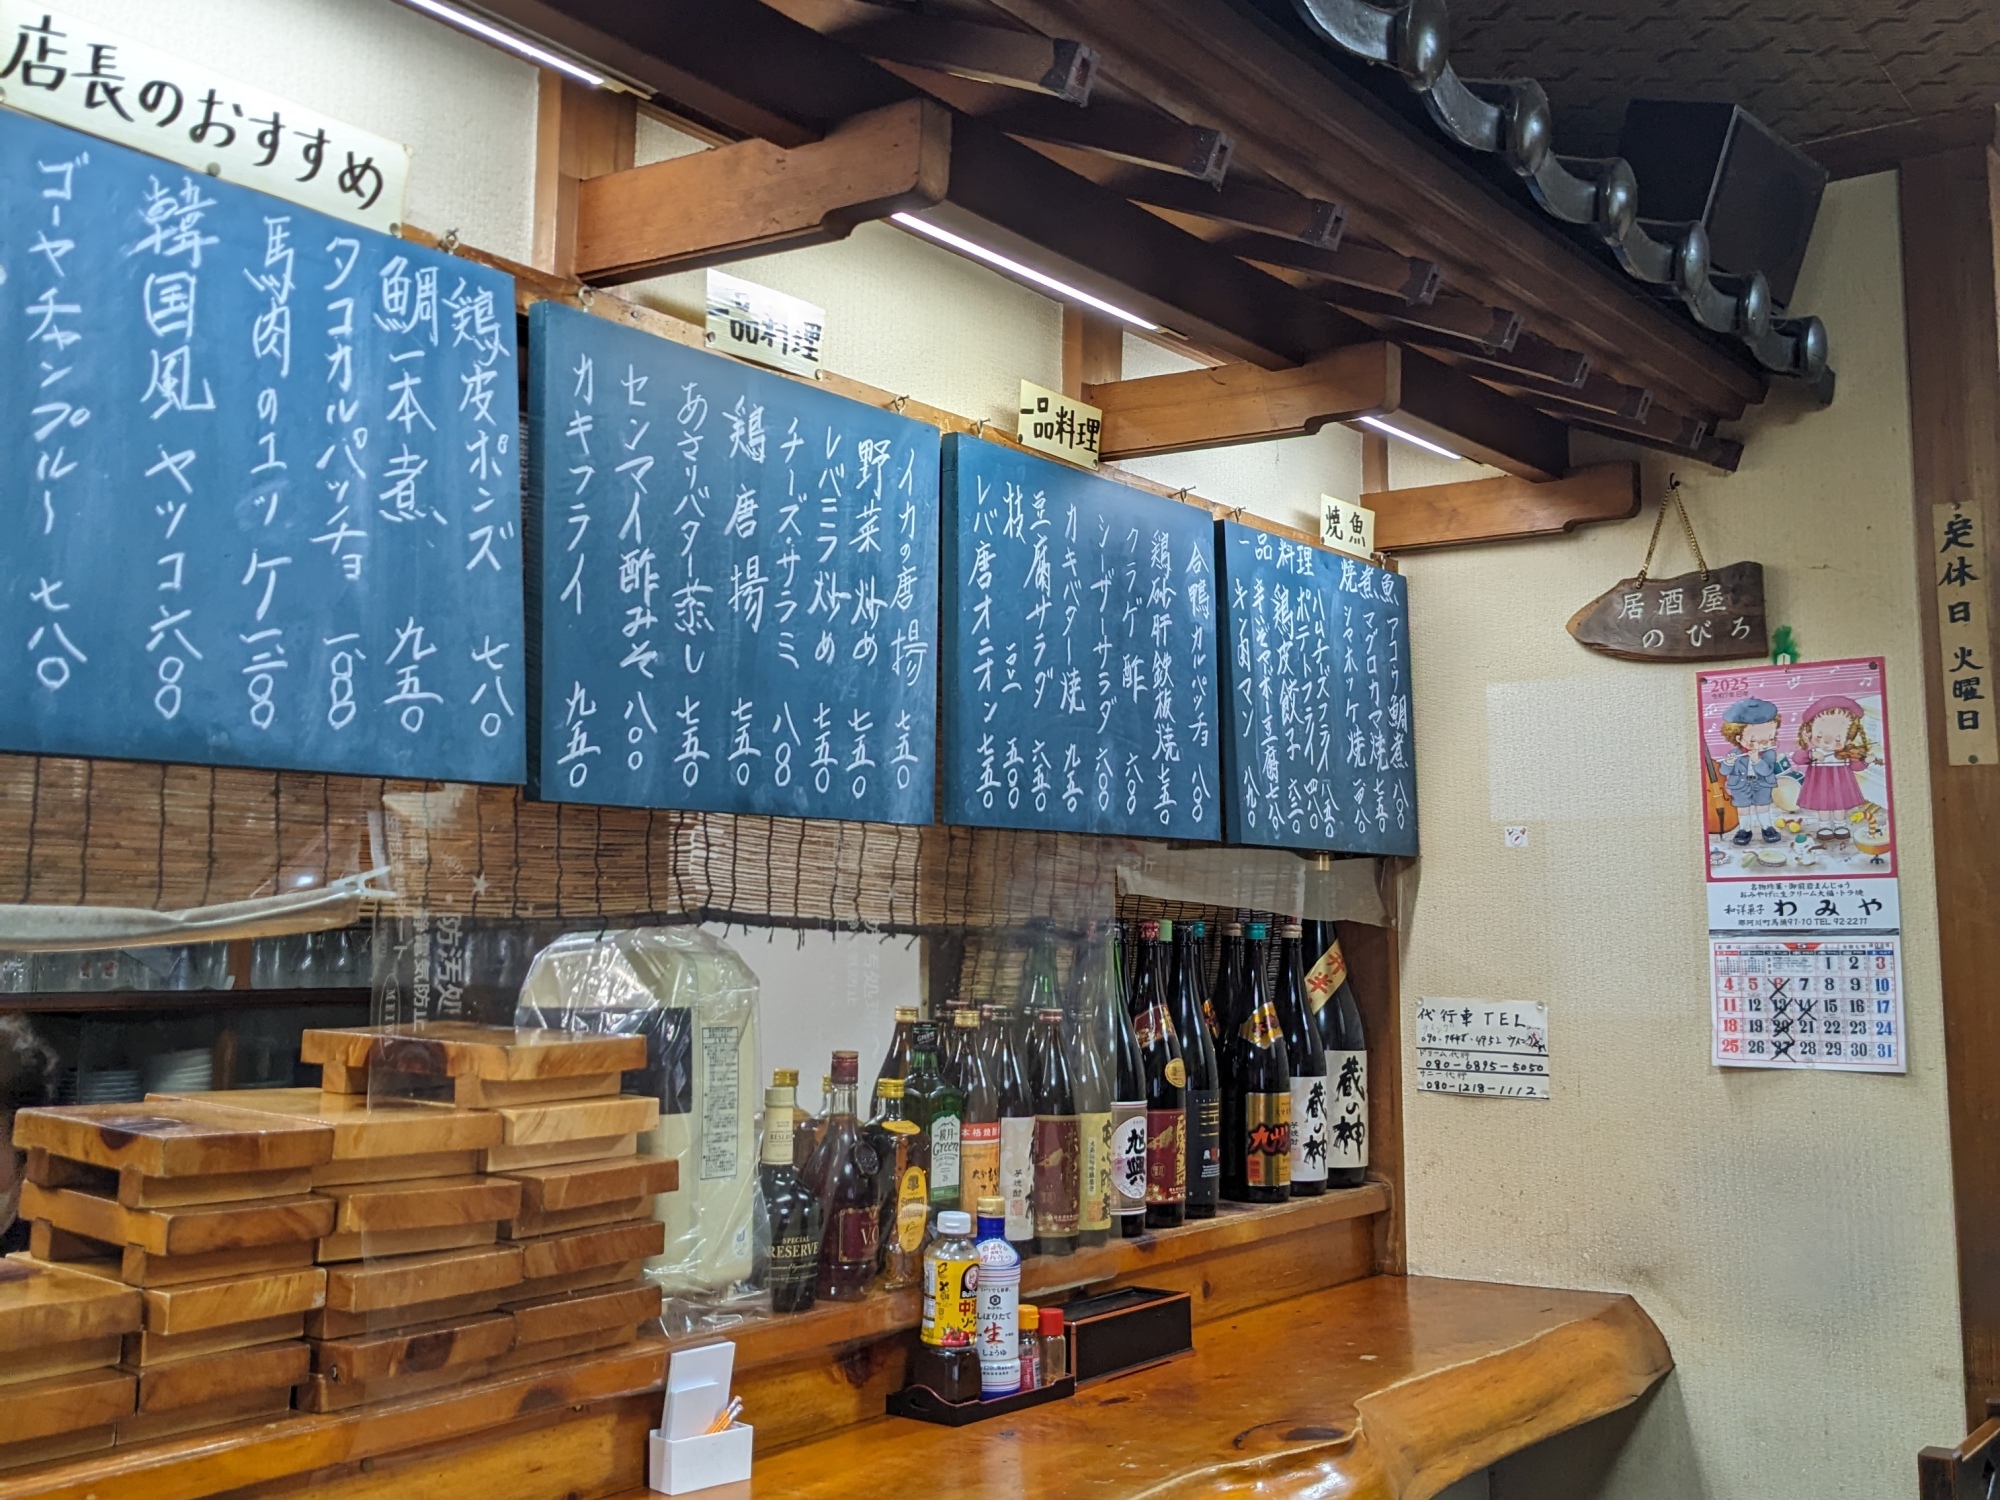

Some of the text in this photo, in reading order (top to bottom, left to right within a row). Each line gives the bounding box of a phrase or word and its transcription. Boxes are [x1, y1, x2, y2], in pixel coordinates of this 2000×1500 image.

[0, 14, 384, 211] 店長のおすすめ
[310, 236, 368, 580] タコカルパッチョ
[1020, 397, 1101, 453] 一品料理
[560, 353, 600, 616] カキフライ
[1326, 505, 1365, 547] 焼魚
[850, 439, 893, 668] 野菜炒め
[1238, 533, 1315, 577] 一品料理
[889, 447, 929, 688] イカの唐揚
[1022, 490, 1054, 709] 豆腐サラダ
[1060, 502, 1086, 715] カキバター焼
[1618, 583, 1726, 620] 居酒屋
[1090, 514, 1117, 735] シーザーサラダ
[1122, 527, 1148, 704] クラゲ酢
[1937, 513, 1986, 731] 定休日 火曜日
[1642, 616, 1750, 648] のびろ
[1711, 677, 1748, 692] 2025
[1724, 898, 1882, 917] 和洋菓子 わみや
[1814, 918, 1832, 926] TEL
[1833, 917, 1868, 926] 92-2211
[1825, 957, 1831, 969] 1
[1849, 956, 1859, 969] 2
[1876, 957, 1885, 969] 3
[1724, 978, 1734, 991] 4
[1749, 978, 1758, 990] 5
[1799, 978, 1809, 990] 7
[1825, 978, 1834, 990] 8
[1851, 978, 1860, 991] 9
[1875, 978, 1889, 992] 10
[1417, 1006, 1526, 1028] 代行車 TEL
[1723, 999, 1736, 1011] 11
[1748, 999, 1761, 1011] 12
[1824, 999, 1837, 1012] 15
[1850, 1000, 1864, 1012] 16
[1877, 1000, 1889, 1013] 17
[1723, 1019, 1737, 1032] 18
[1749, 1020, 1763, 1033] 19
[1799, 1021, 1814, 1033] 21
[1824, 1021, 1840, 1034] 22
[1850, 1021, 1866, 1034] 23
[1876, 1022, 1892, 1035] 24
[1722, 1040, 1739, 1052] 25
[1748, 1041, 1764, 1053] 26
[1800, 1042, 1816, 1054] 28
[1825, 1042, 1841, 1055] 29
[1851, 1043, 1867, 1056] 30
[1878, 1044, 1892, 1057] 31
[1426, 1059, 1543, 1072] 080-6895-5050
[1426, 1081, 1536, 1095] 080-1218-1112
[1332, 1055, 1366, 1164] 蔵の神
[932, 1140, 959, 1156] Green
[770, 1241, 818, 1259] RESERVE
[782, 1235, 810, 1244] SPECIAL
[977, 1312, 1011, 1320] しぼりたて
[983, 1321, 1005, 1344] 生
[982, 1349, 1007, 1357] しょうゆ
